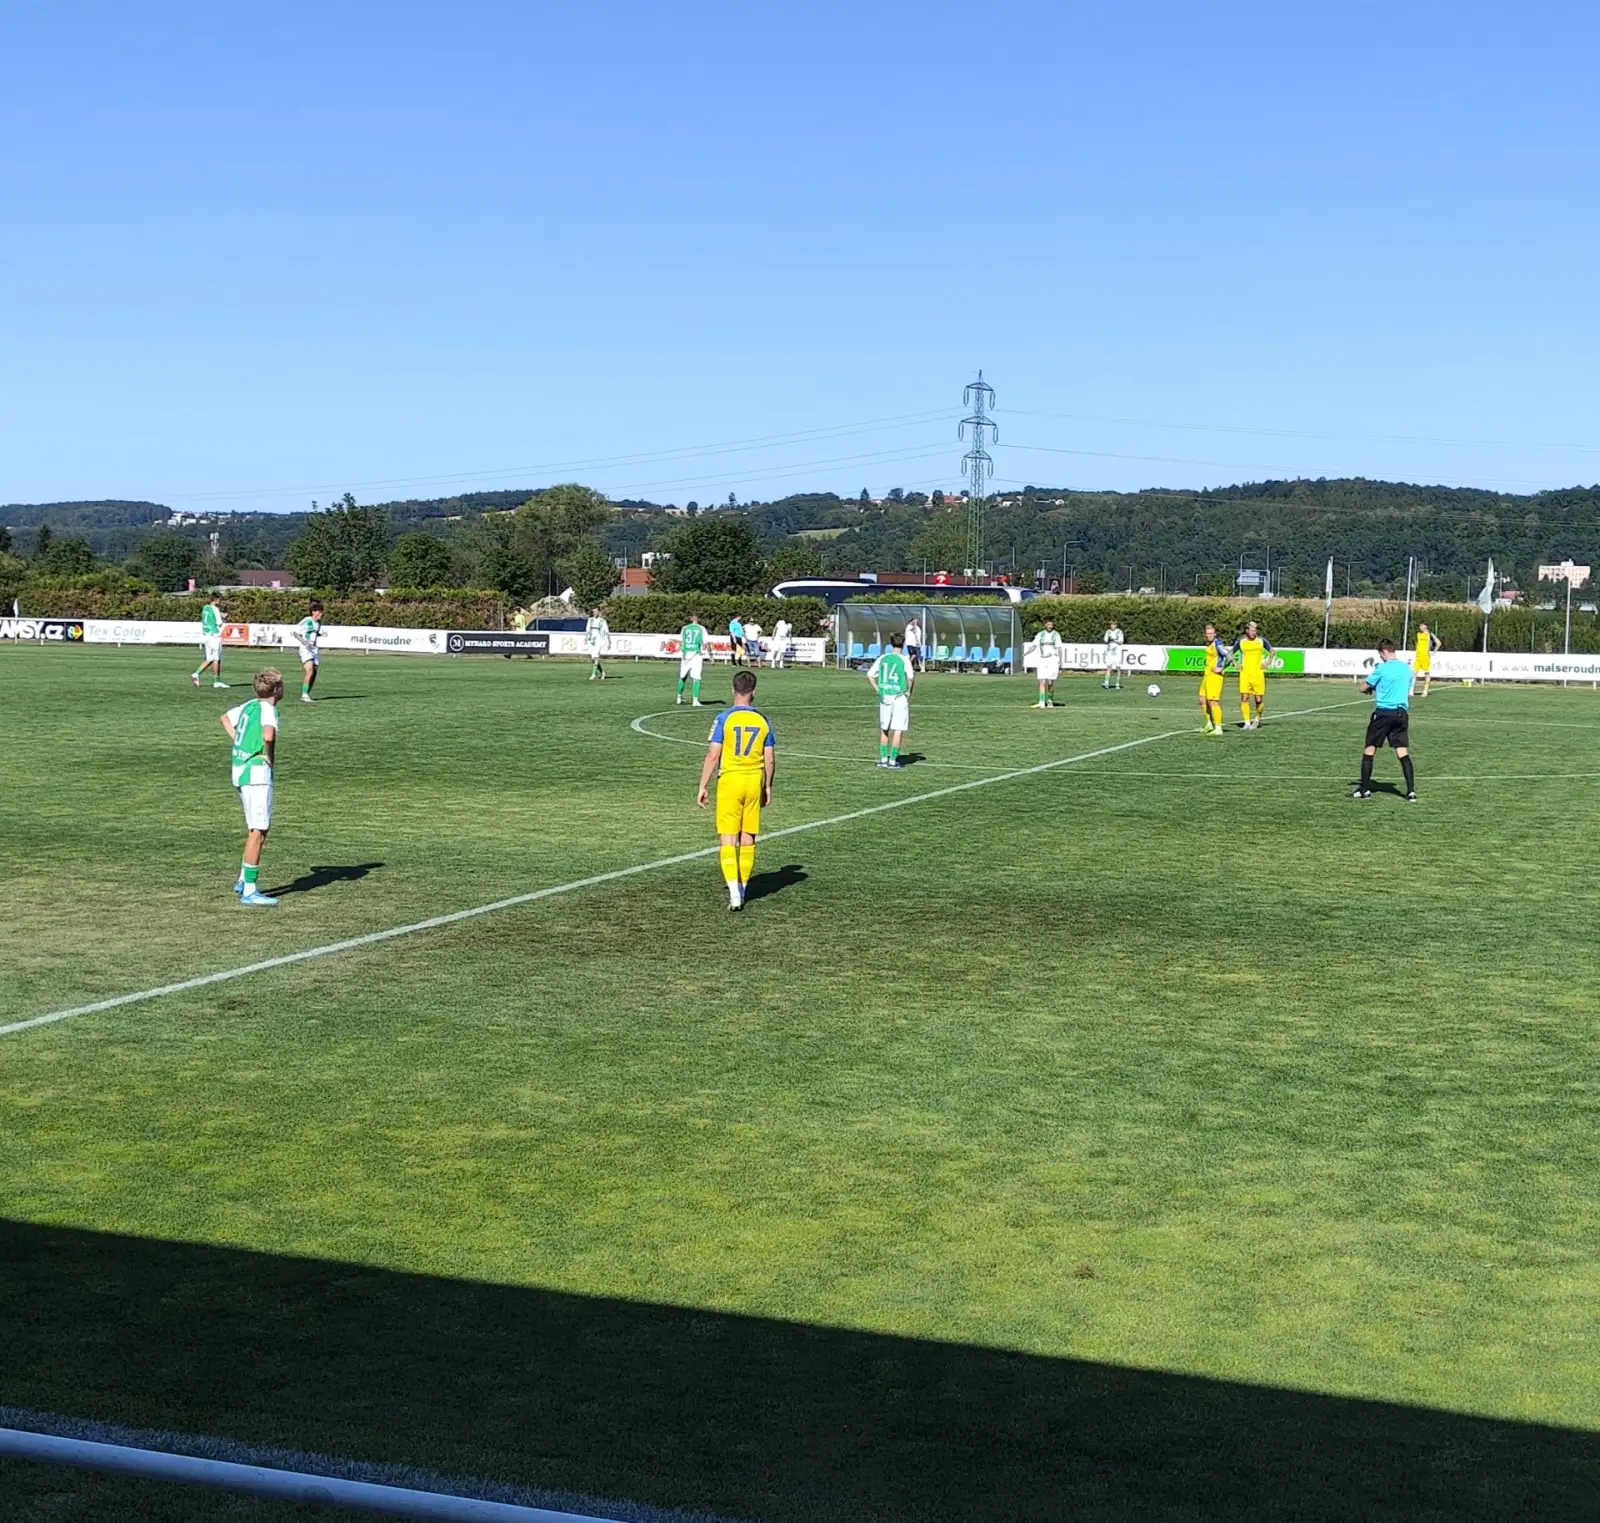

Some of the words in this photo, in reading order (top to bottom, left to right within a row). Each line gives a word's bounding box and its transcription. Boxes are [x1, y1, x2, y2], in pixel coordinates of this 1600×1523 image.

[351, 634, 412, 646] malseroudne
[685, 629, 700, 645] 37
[882, 661, 900, 684] 14
[732, 725, 762, 757] 17
